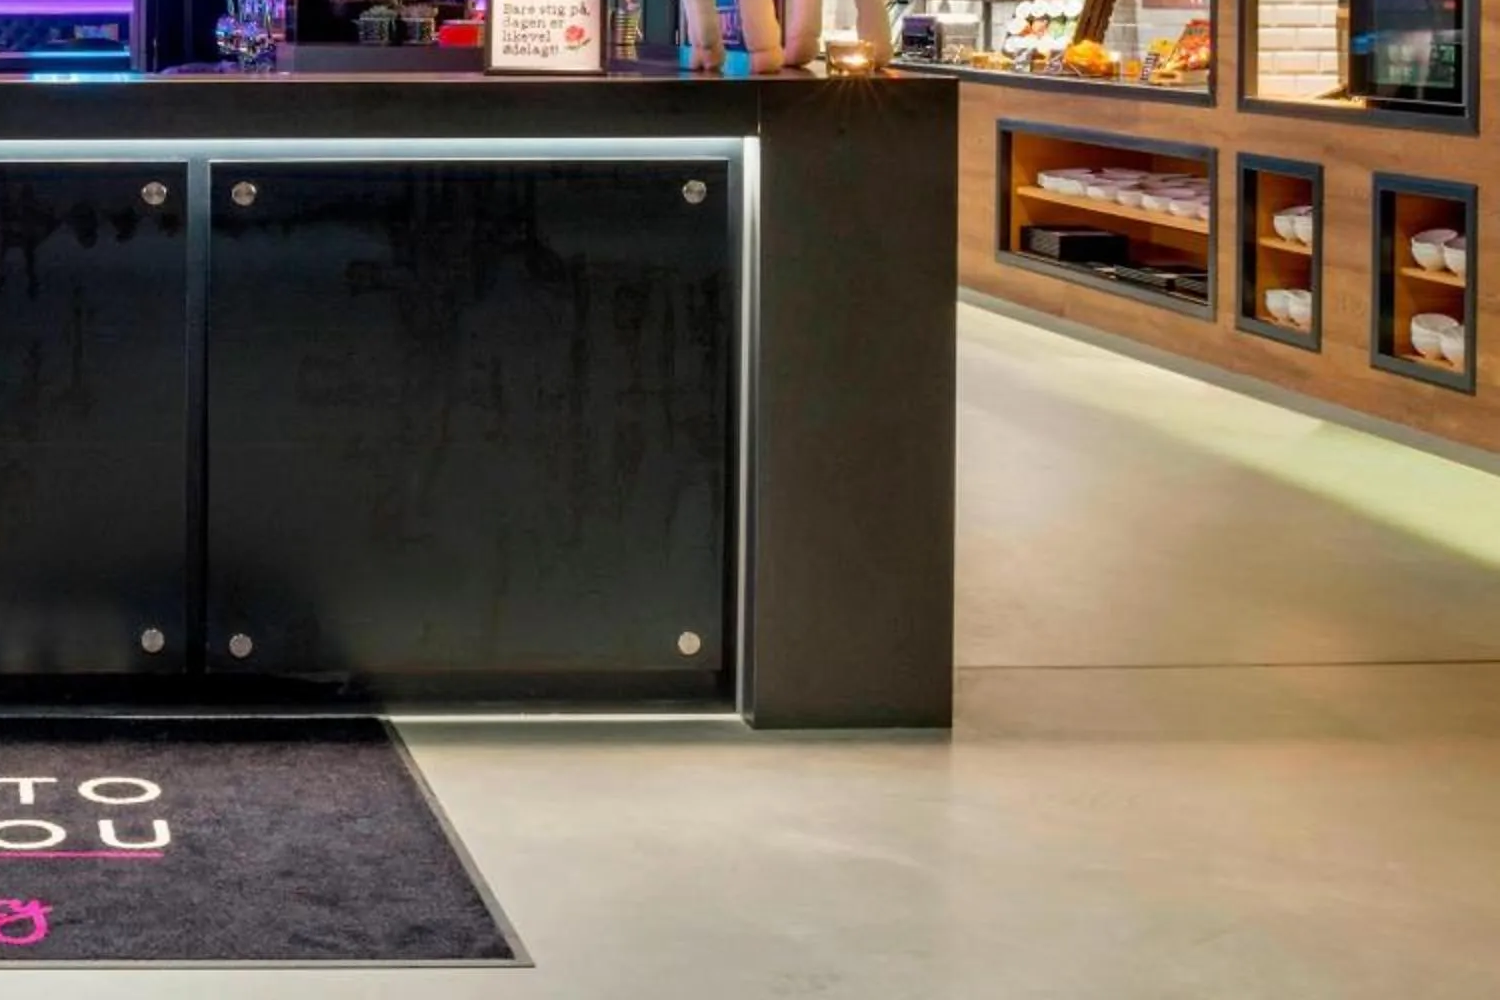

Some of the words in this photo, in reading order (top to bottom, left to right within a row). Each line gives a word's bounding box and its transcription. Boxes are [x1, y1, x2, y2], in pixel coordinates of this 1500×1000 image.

[503, 3, 536, 15] Bare
[550, 18, 564, 29] er
[503, 29, 551, 42] likevel
